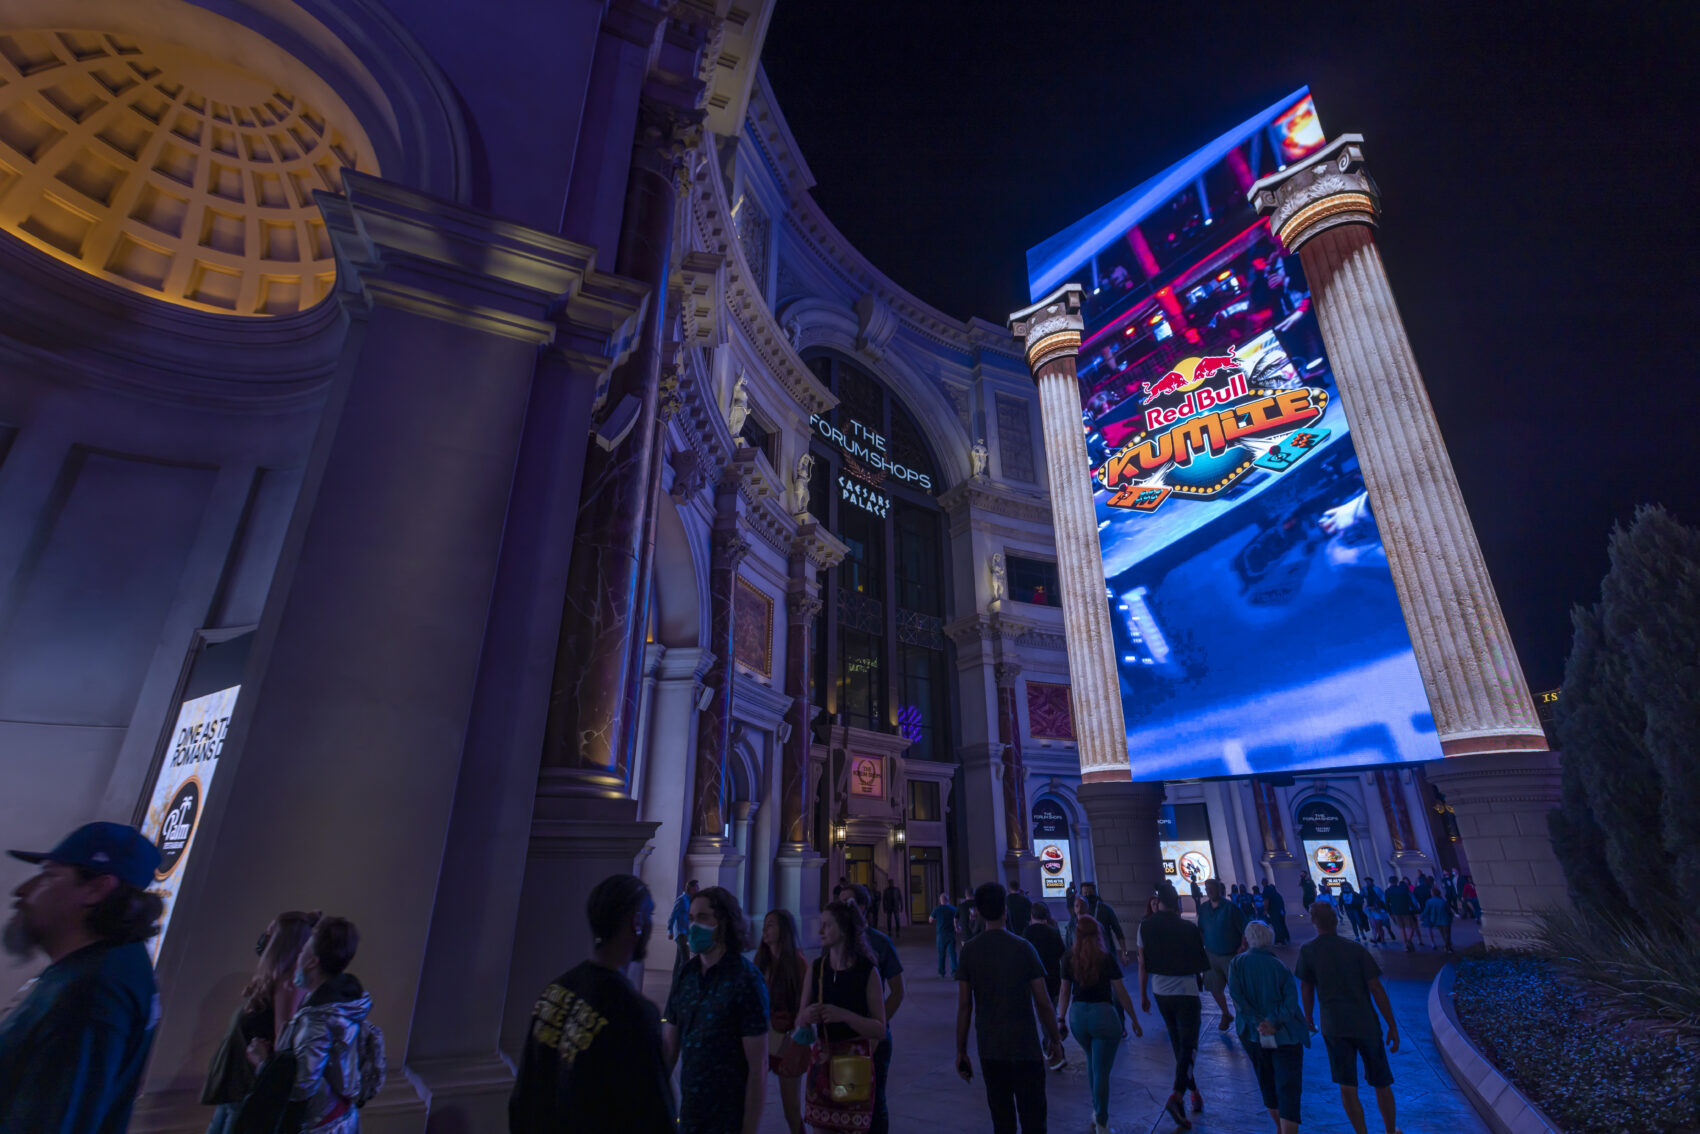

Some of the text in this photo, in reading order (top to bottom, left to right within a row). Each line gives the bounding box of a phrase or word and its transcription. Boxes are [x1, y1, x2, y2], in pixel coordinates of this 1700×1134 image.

[1145, 373, 1249, 430] Red Bull
[850, 419, 886, 452] THE
[838, 475, 890, 509] CAESARS
[842, 488, 887, 519] PALACE
[177, 723, 203, 748] DINE
[200, 720, 217, 744] AS
[170, 741, 217, 768] ROMANS
[162, 796, 193, 840] Palm
